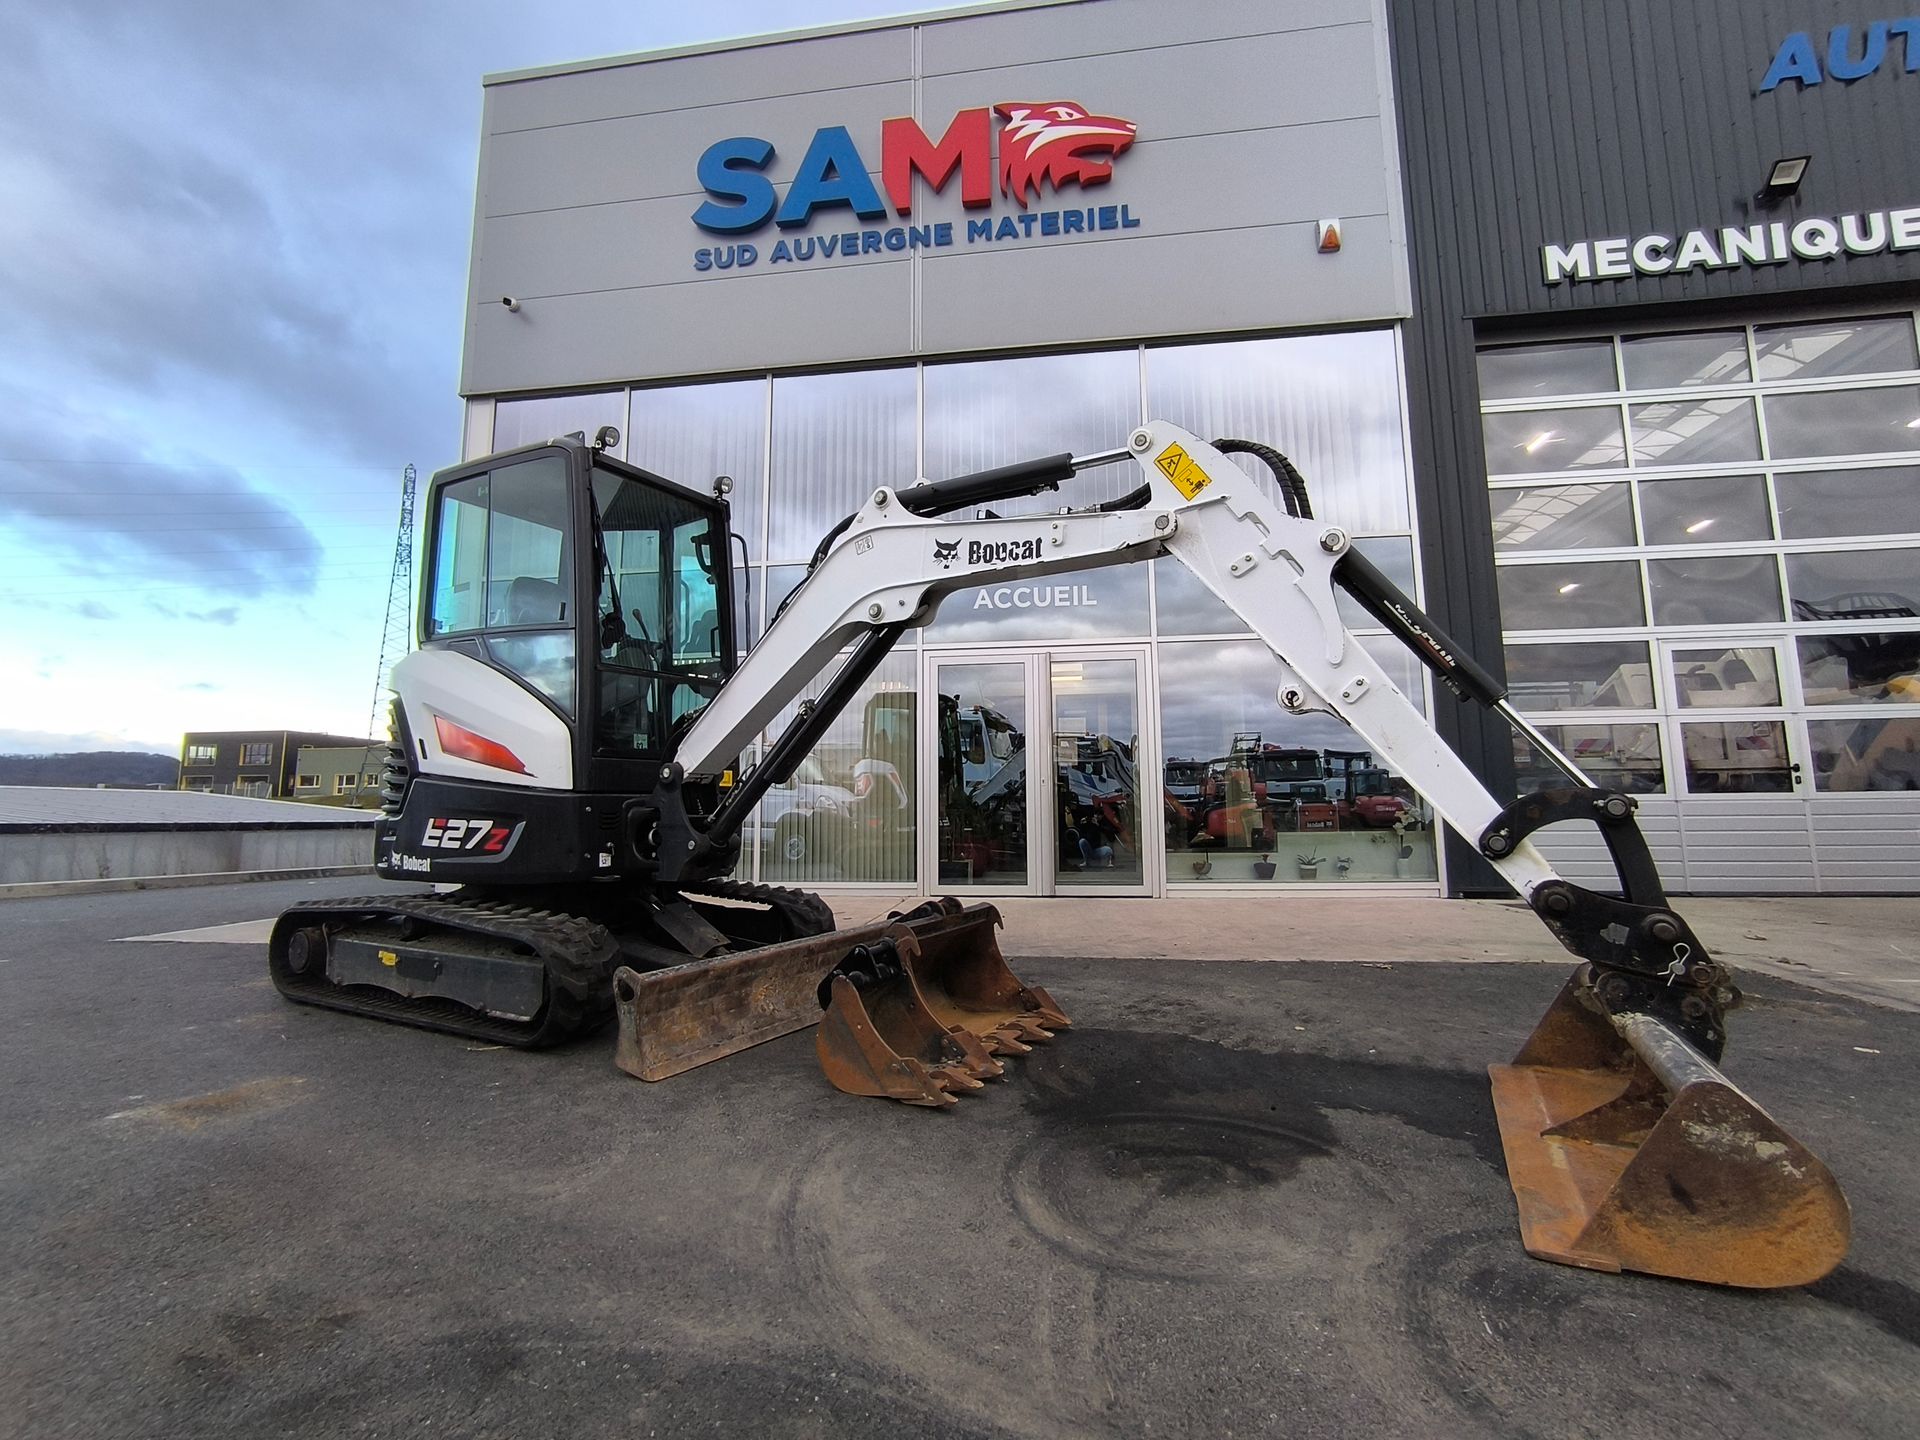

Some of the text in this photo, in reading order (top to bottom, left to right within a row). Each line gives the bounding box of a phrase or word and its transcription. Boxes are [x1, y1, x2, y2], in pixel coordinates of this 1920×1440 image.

[691, 107, 992, 233] SAM
[694, 204, 1140, 270] SUD AUVERGNE MATERIEL
[1544, 208, 1920, 280] MECANIQUE
[968, 537, 1042, 565] Bobcat
[973, 585, 1097, 609] ACCUEIL
[402, 855, 431, 872] Bobcat
